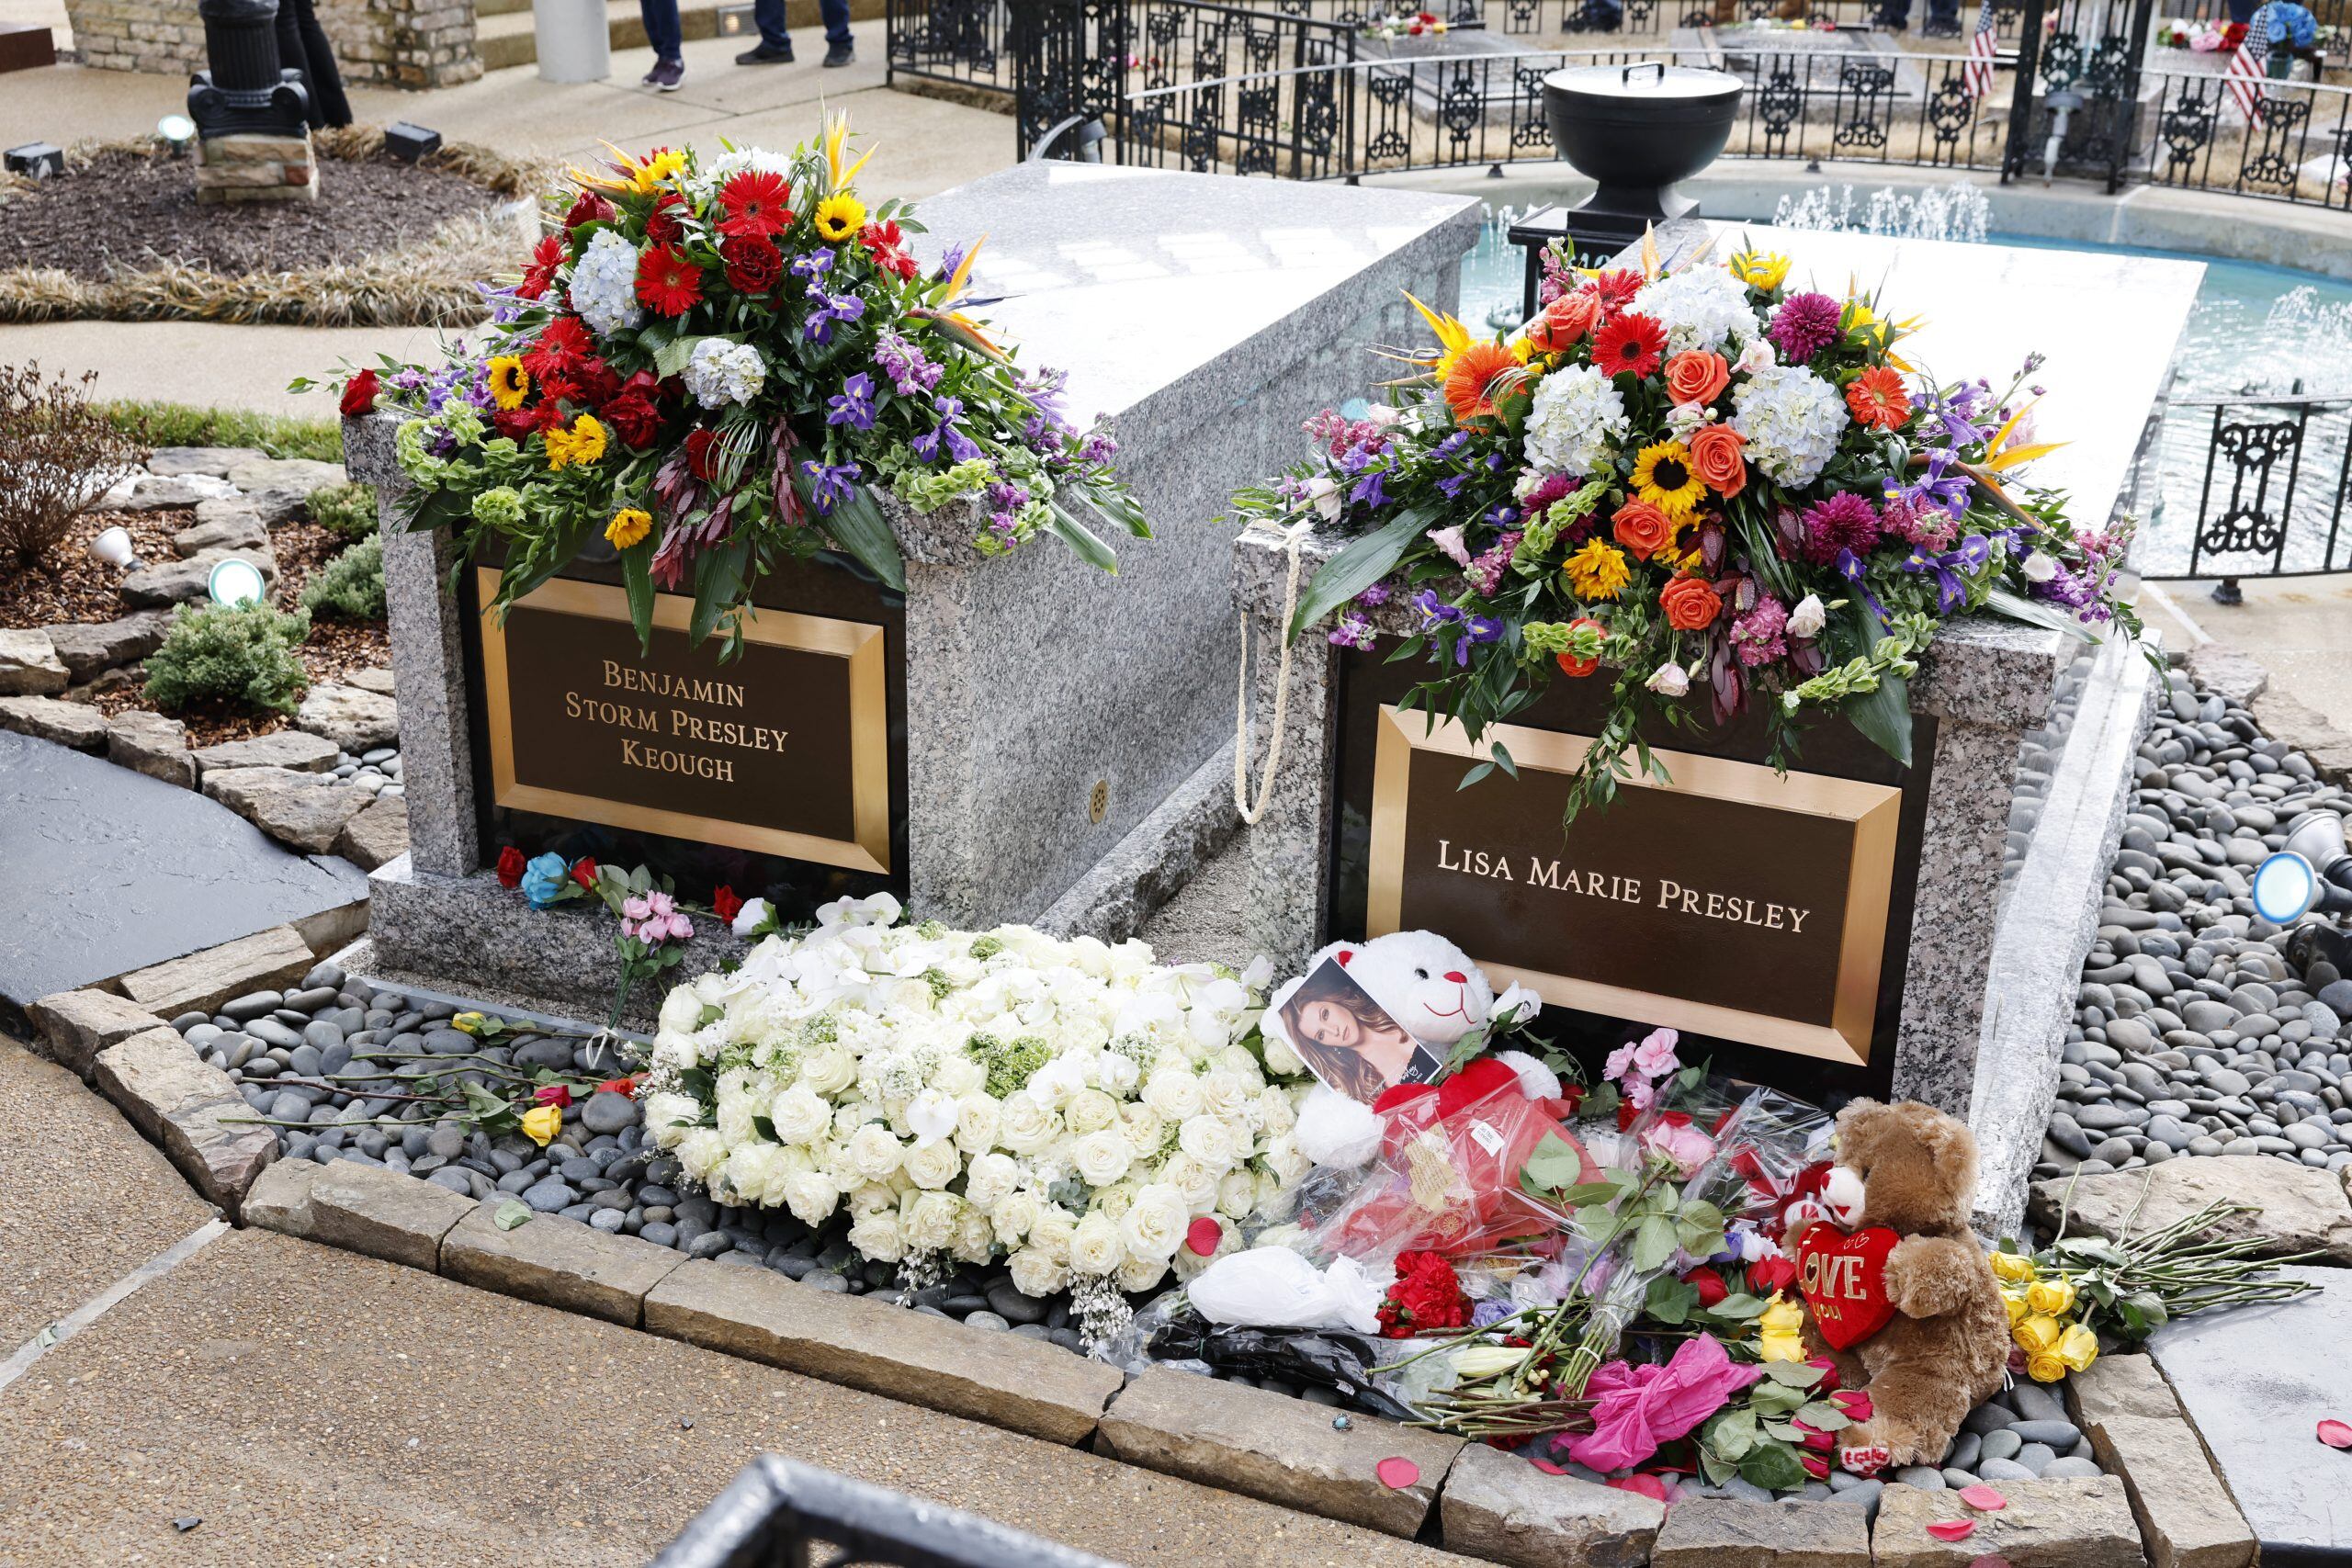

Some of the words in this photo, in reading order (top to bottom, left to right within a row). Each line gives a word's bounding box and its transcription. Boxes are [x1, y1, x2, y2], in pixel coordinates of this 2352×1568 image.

[602, 660, 744, 707] BENJAMIN
[566, 691, 659, 733] STORM
[672, 709, 789, 753] PRESLEY
[621, 738, 736, 783] KEOUGH
[1437, 840, 1514, 881] LISA
[1526, 856, 1642, 905] MARIE
[1657, 879, 1811, 933] PRESLEY
[1795, 1249, 1867, 1300] LOVE
